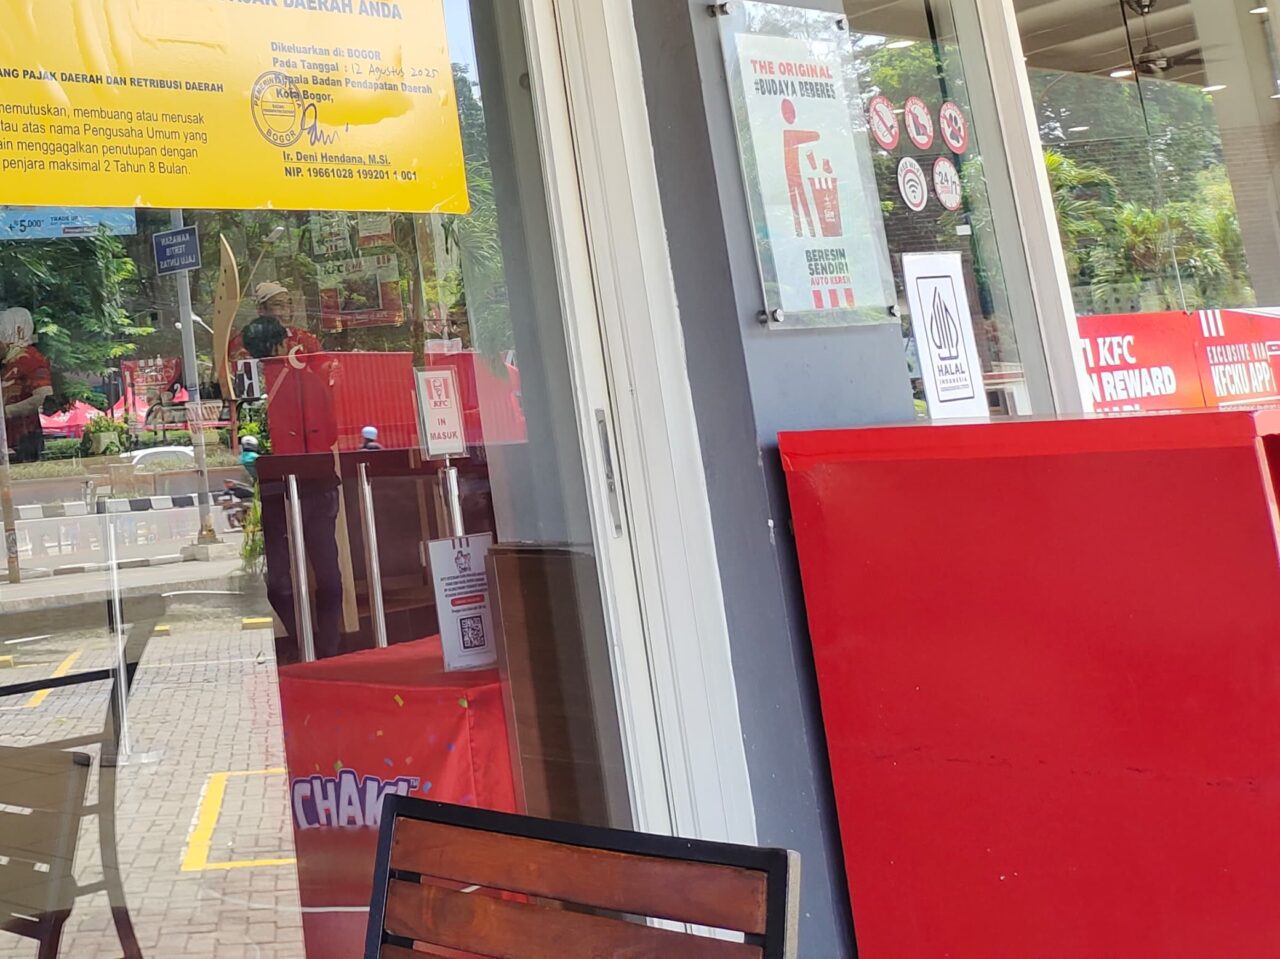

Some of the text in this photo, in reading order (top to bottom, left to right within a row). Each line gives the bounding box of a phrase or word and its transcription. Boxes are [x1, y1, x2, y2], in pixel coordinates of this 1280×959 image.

[358, 0, 401, 19] ANDA
[750, 59, 833, 79] THE ORIGINAL
[22, 69, 57, 84] PAJAK
[60, 72, 102, 84] DAERAH
[105, 74, 126, 85] DAN
[129, 77, 182, 89] RETRIBUSI
[184, 81, 223, 92] DAERAH
[754, 78, 836, 100] #BUDAYA BEBERES
[73, 107, 132, 123] membuang
[135, 110, 158, 121] atau
[161, 112, 204, 124] merusak
[21, 121, 45, 133] atas
[49, 124, 80, 135] nama
[83, 123, 143, 139] Pengusaha
[146, 126, 180, 139] Umum
[182, 131, 207, 144] yang
[16, 138, 99, 157] menggagalkan
[101, 144, 157, 157] penutupan
[160, 145, 197, 160] dengan
[2, 156, 45, 172] penjara
[48, 158, 100, 171] maksimal
[112, 159, 145, 172] Tahun
[158, 161, 190, 174] Bulan.
[805, 248, 846, 263] BERESIN
[808, 261, 849, 276] SENDIRI
[811, 276, 829, 286] AUTO
[1097, 335, 1137, 367] KFC
[1206, 342, 1268, 364] EXCLUSIVE VIA
[937, 362, 966, 377] HALAL
[1102, 365, 1177, 402] REWARD
[1211, 363, 1250, 397] KFCKU
[437, 417, 447, 426] IN
[430, 431, 458, 441] MASUK
